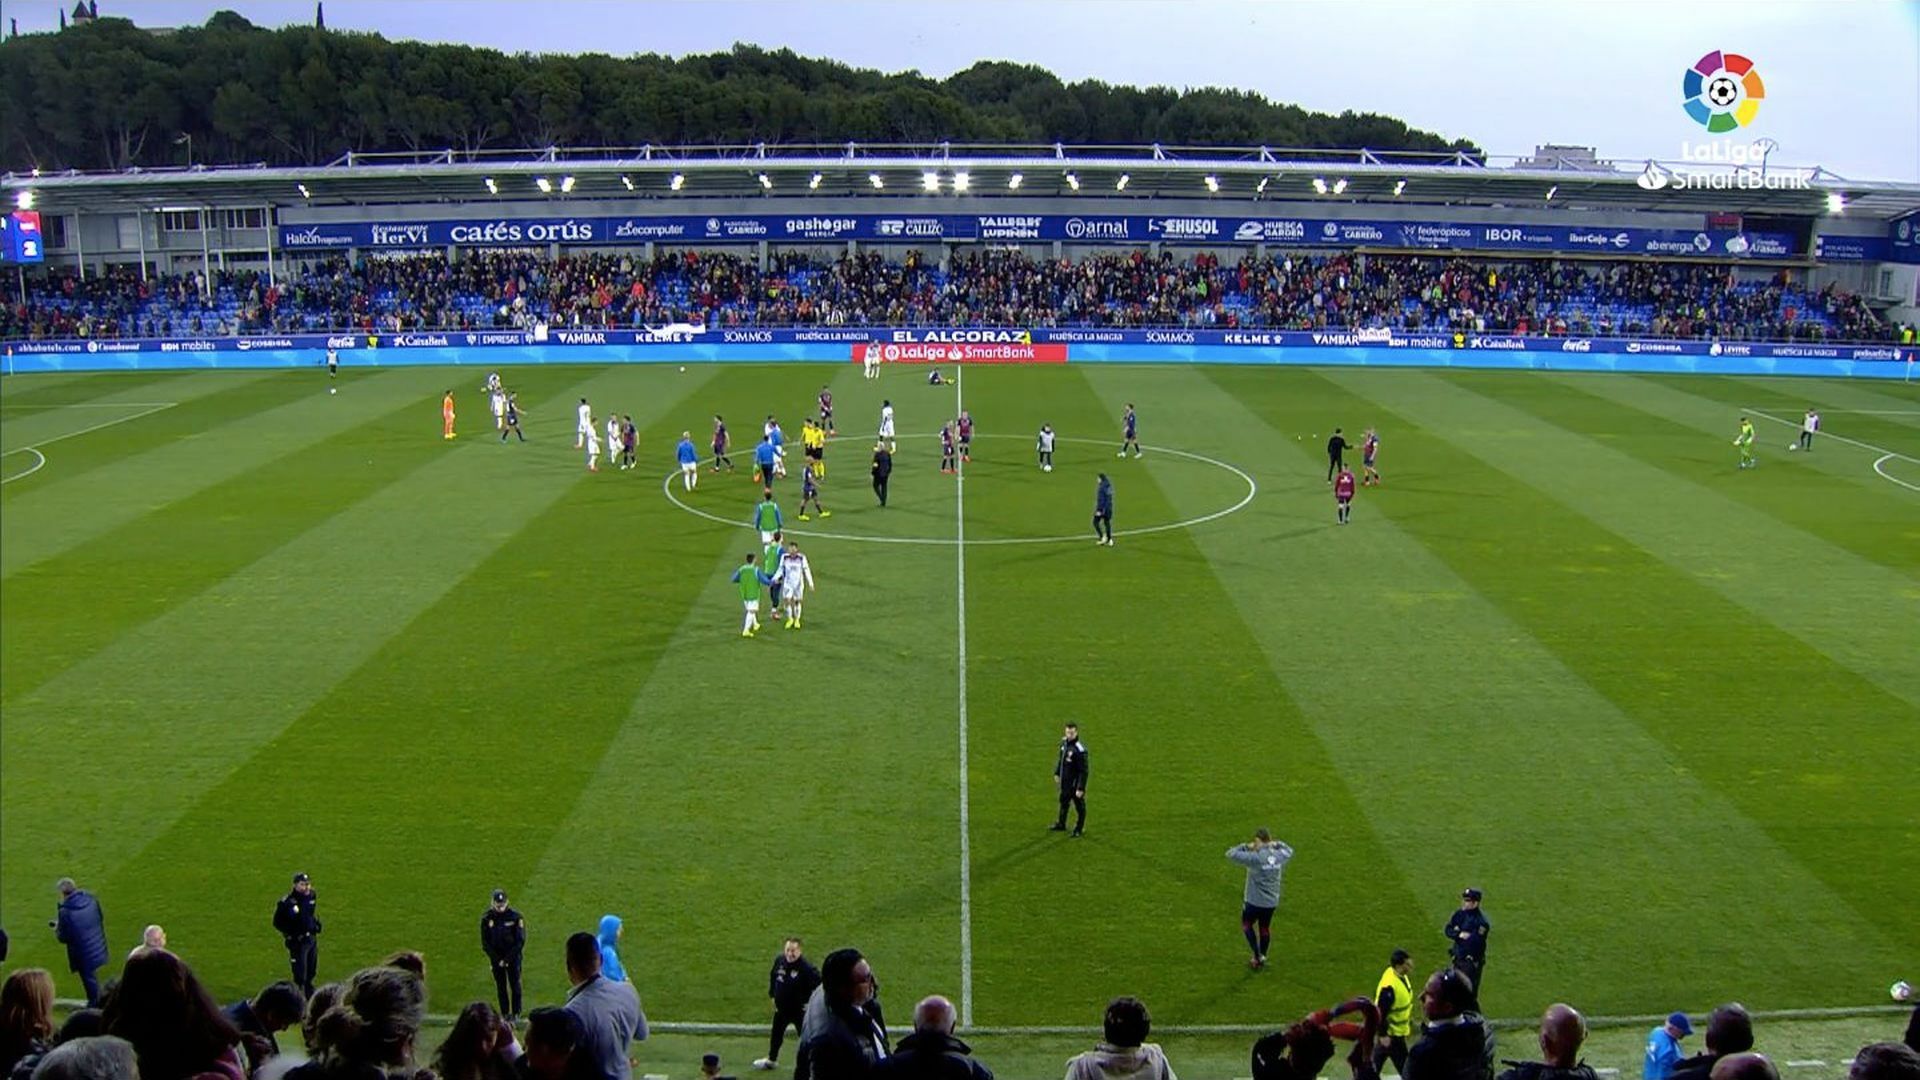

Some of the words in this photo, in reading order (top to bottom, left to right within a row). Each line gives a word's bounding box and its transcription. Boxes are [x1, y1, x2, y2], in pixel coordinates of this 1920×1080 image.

[786, 217, 857, 233] gashogar
[978, 216, 1042, 227] TALLERES
[1086, 218, 1129, 235] arnal
[1264, 221, 1304, 229] HUESCA
[1264, 228, 1304, 237] GARDEN
[1344, 230, 1383, 240] CABRERO
[1485, 228, 1522, 241] IBOR
[23, 240, 38, 257] 2
[566, 333, 606, 345] AMBAR
[724, 331, 773, 343] SOMMOS
[893, 331, 918, 343] EL
[924, 331, 1025, 343] ALCORAZ
[1145, 331, 1195, 343] SOMMOS
[1224, 334, 1271, 344] KELME
[1320, 334, 1360, 346] AMBAR
[901, 344, 946, 361] LaLiga
[964, 344, 1035, 360] SmartBank
